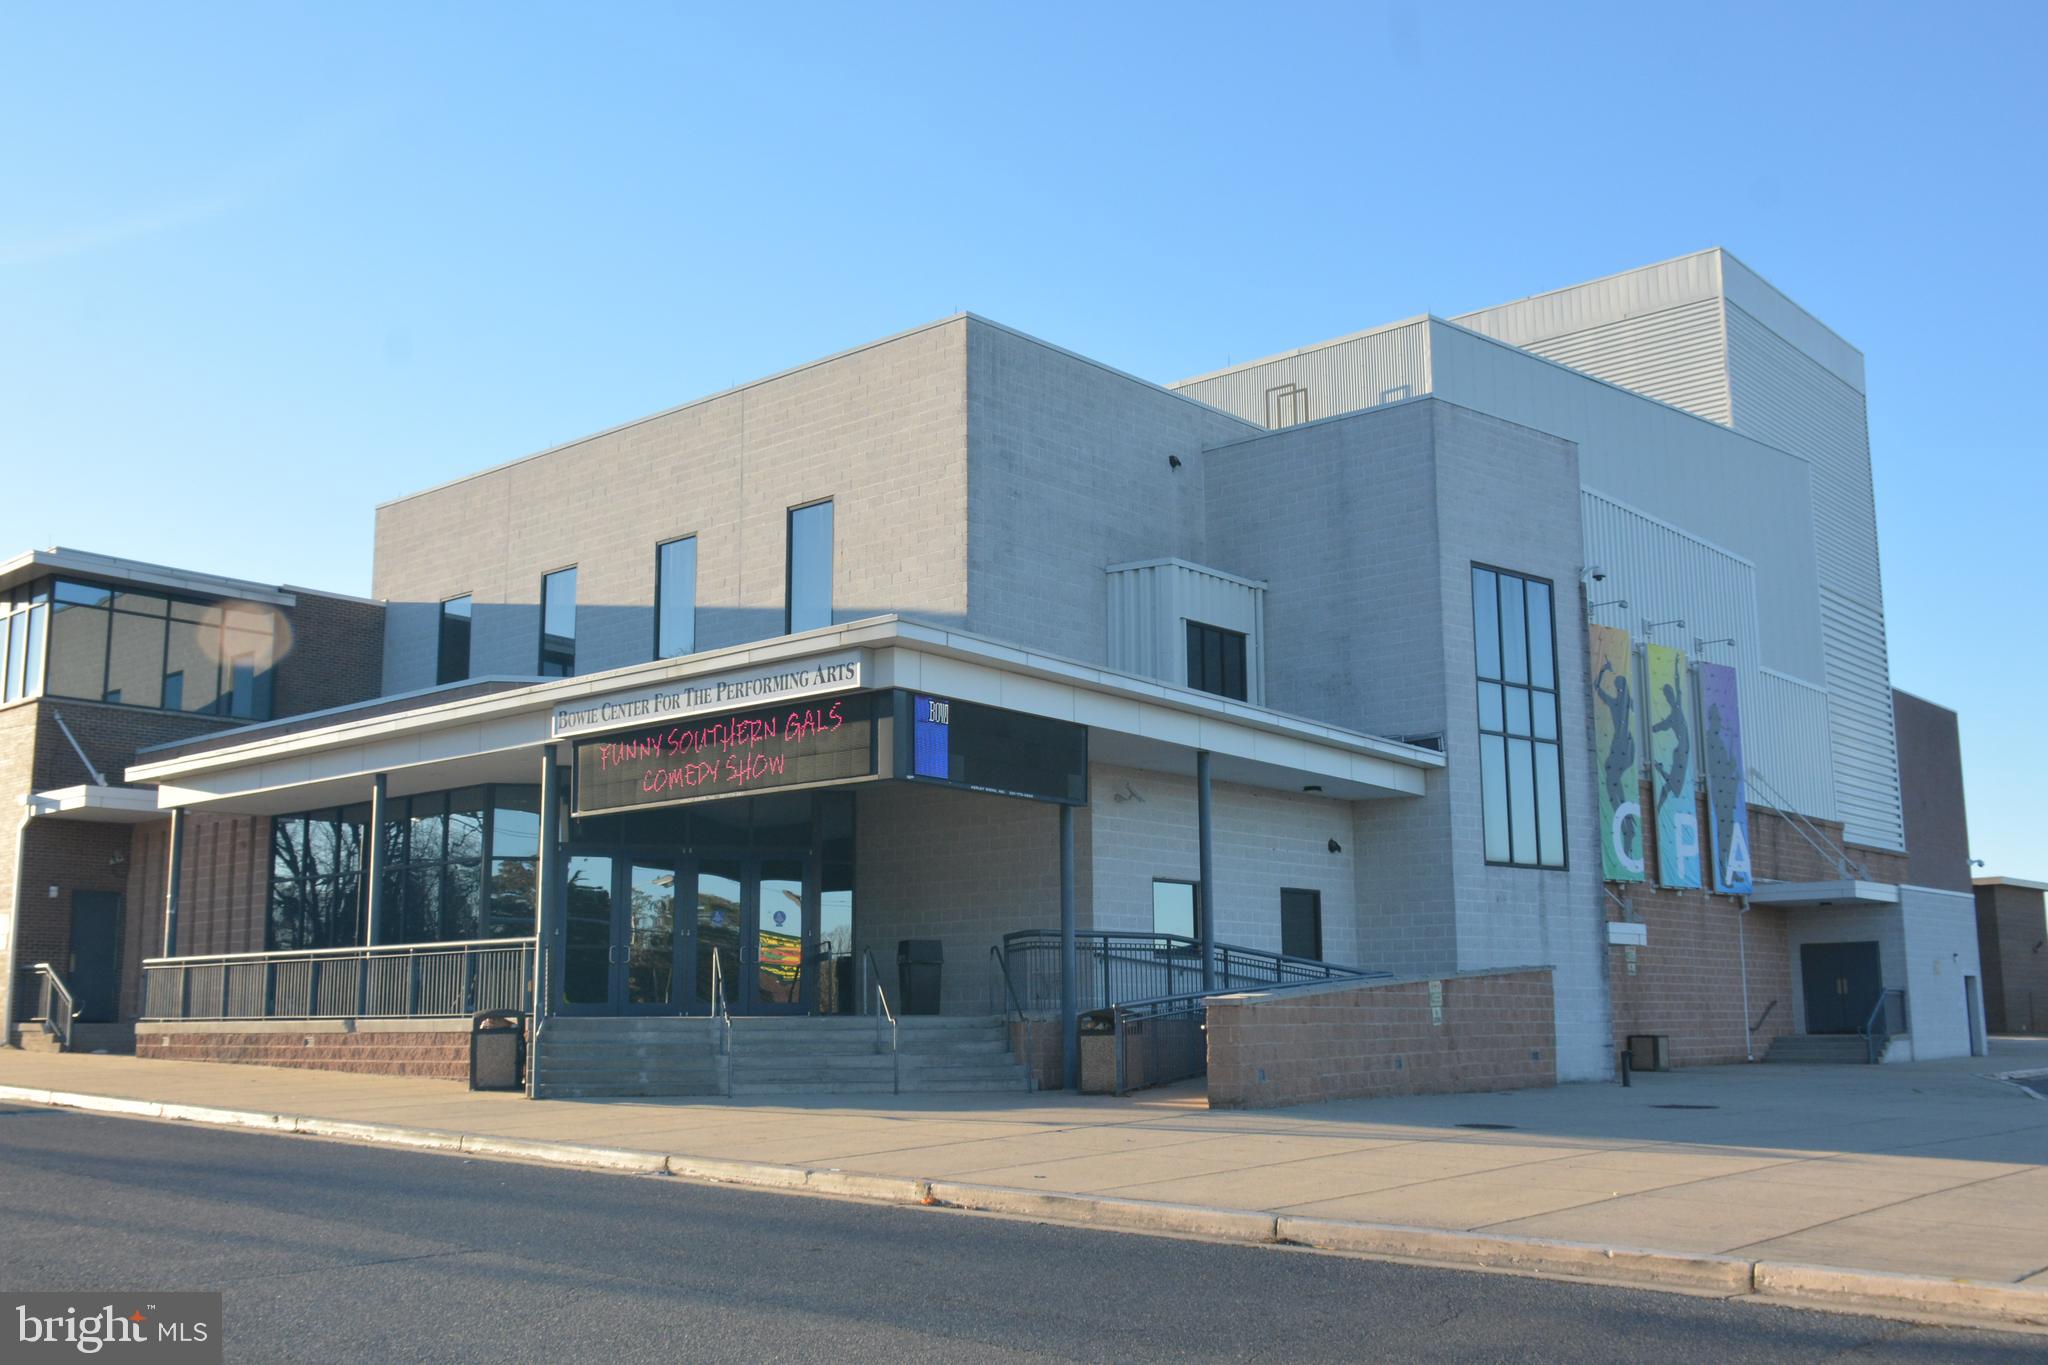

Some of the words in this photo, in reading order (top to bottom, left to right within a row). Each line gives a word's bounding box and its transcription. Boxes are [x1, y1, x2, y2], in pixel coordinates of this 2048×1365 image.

[558, 708, 599, 730] BOWIE
[601, 698, 650, 722] CENTER
[654, 692, 681, 713] FOR
[684, 687, 712, 707] THE
[716, 670, 809, 703] PERFORMING
[813, 661, 856, 686] ARTS
[600, 733, 664, 771] FUNNY
[667, 716, 777, 757] SOUTHERN
[784, 701, 844, 744] GALS
[642, 758, 720, 793] COMEDY
[725, 752, 786, 786] SHOW
